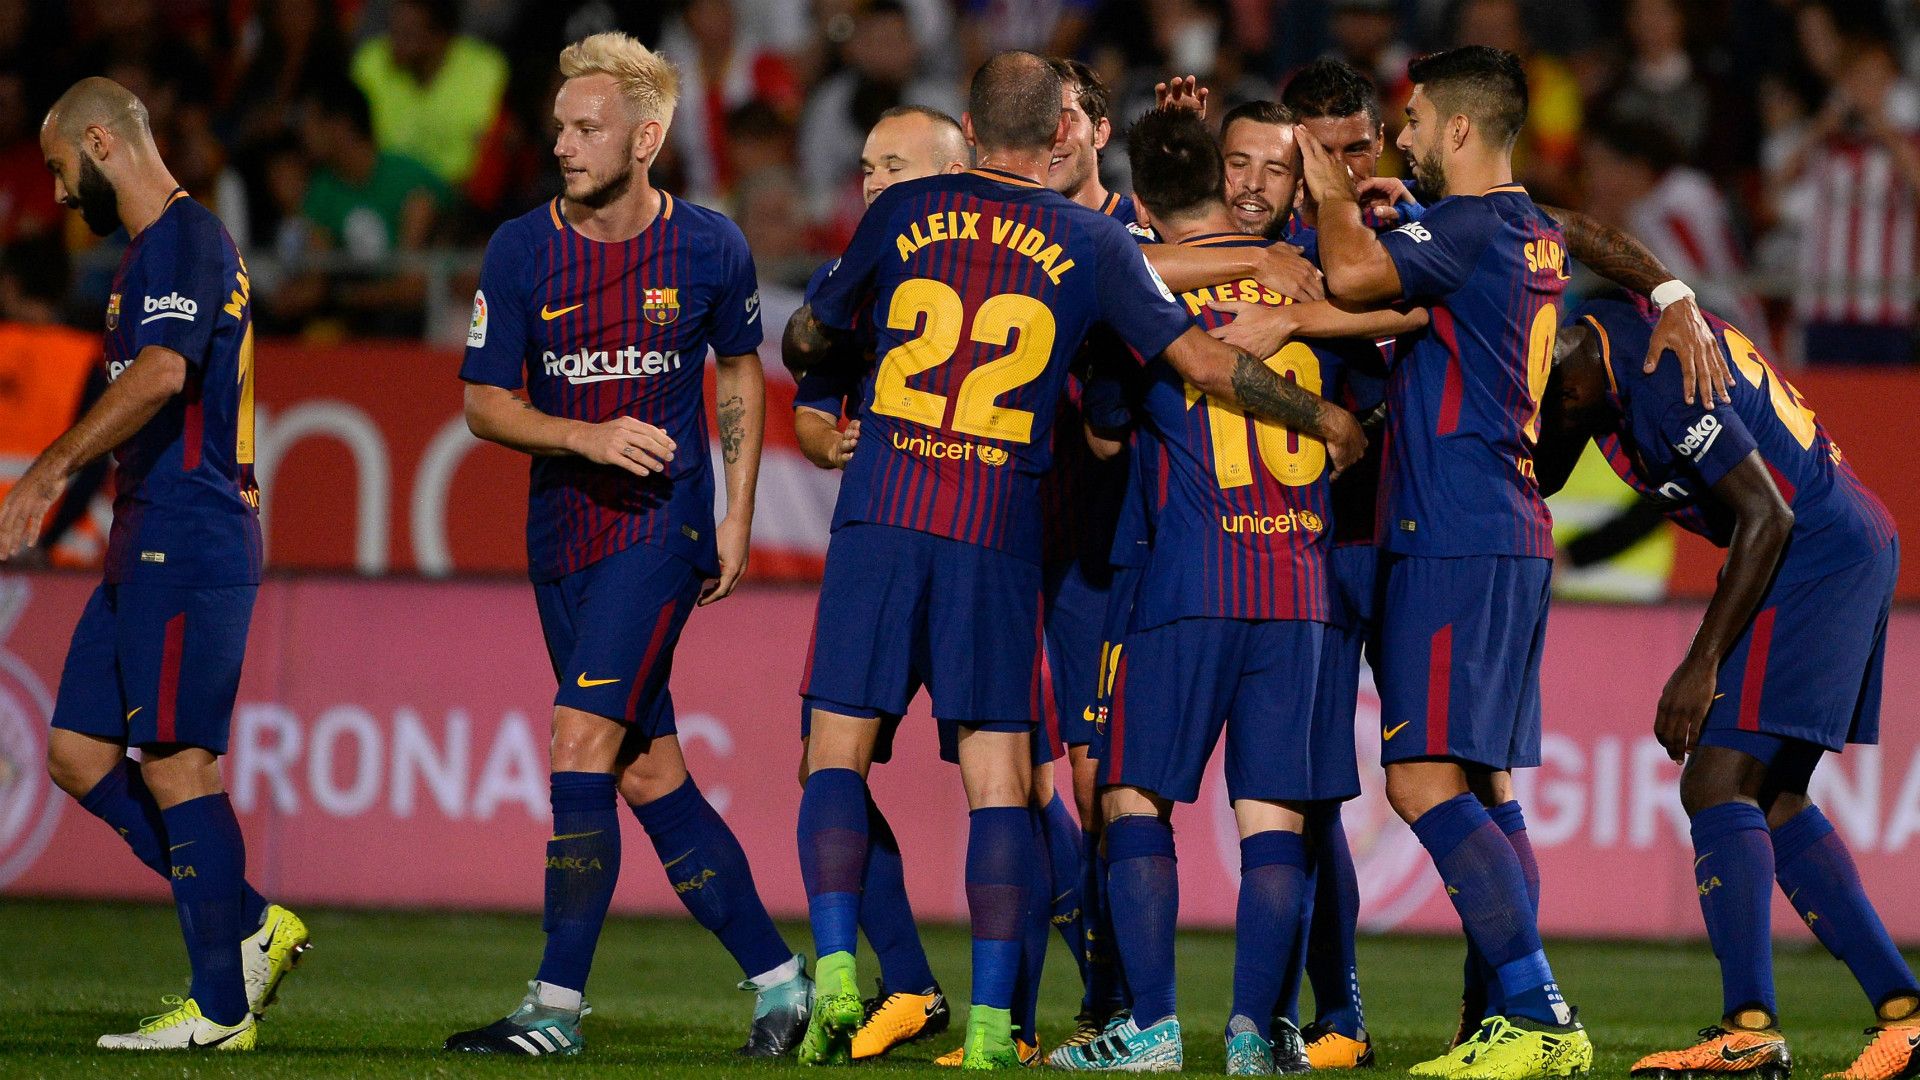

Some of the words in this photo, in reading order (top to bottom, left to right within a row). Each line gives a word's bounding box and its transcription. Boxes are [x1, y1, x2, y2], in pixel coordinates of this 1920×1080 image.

[895, 211, 980, 262] ALEIX
[991, 216, 1075, 285] VIDAL
[143, 292, 198, 314] beko
[542, 345, 681, 378] Rakuten
[870, 278, 1056, 445] 22
[1184, 341, 1326, 490] 10
[1673, 414, 1718, 456] beko
[1222, 508, 1298, 535] unicef
[1541, 1040, 1572, 1070] adidas
